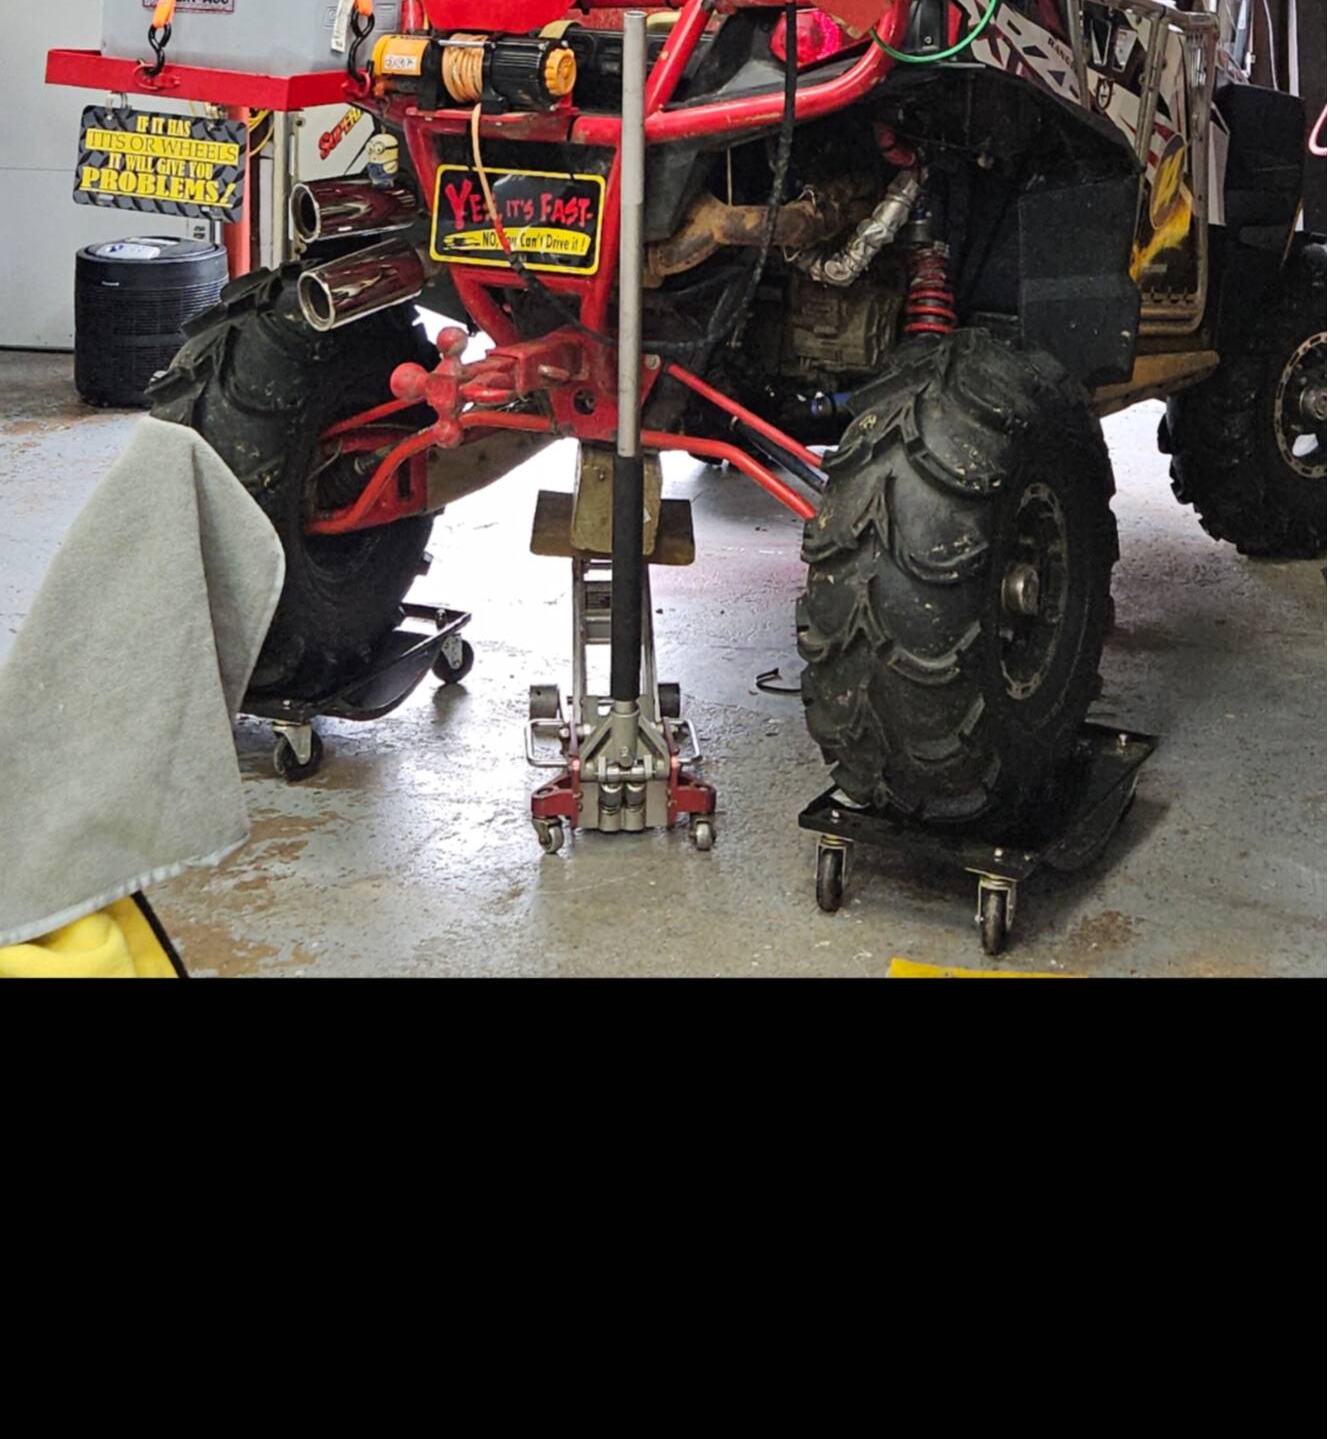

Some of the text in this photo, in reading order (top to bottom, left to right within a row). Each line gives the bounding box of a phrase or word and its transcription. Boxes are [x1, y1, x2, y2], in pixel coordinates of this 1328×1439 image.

[136, 115, 192, 138] IF IT HAS
[88, 131, 238, 163] TITS OR WHEELS
[108, 152, 214, 180] IT WILL GIVE YOU
[506, 198, 534, 221] IT'S
[520, 233, 544, 249] Can't
[545, 234, 569, 251] Drive
